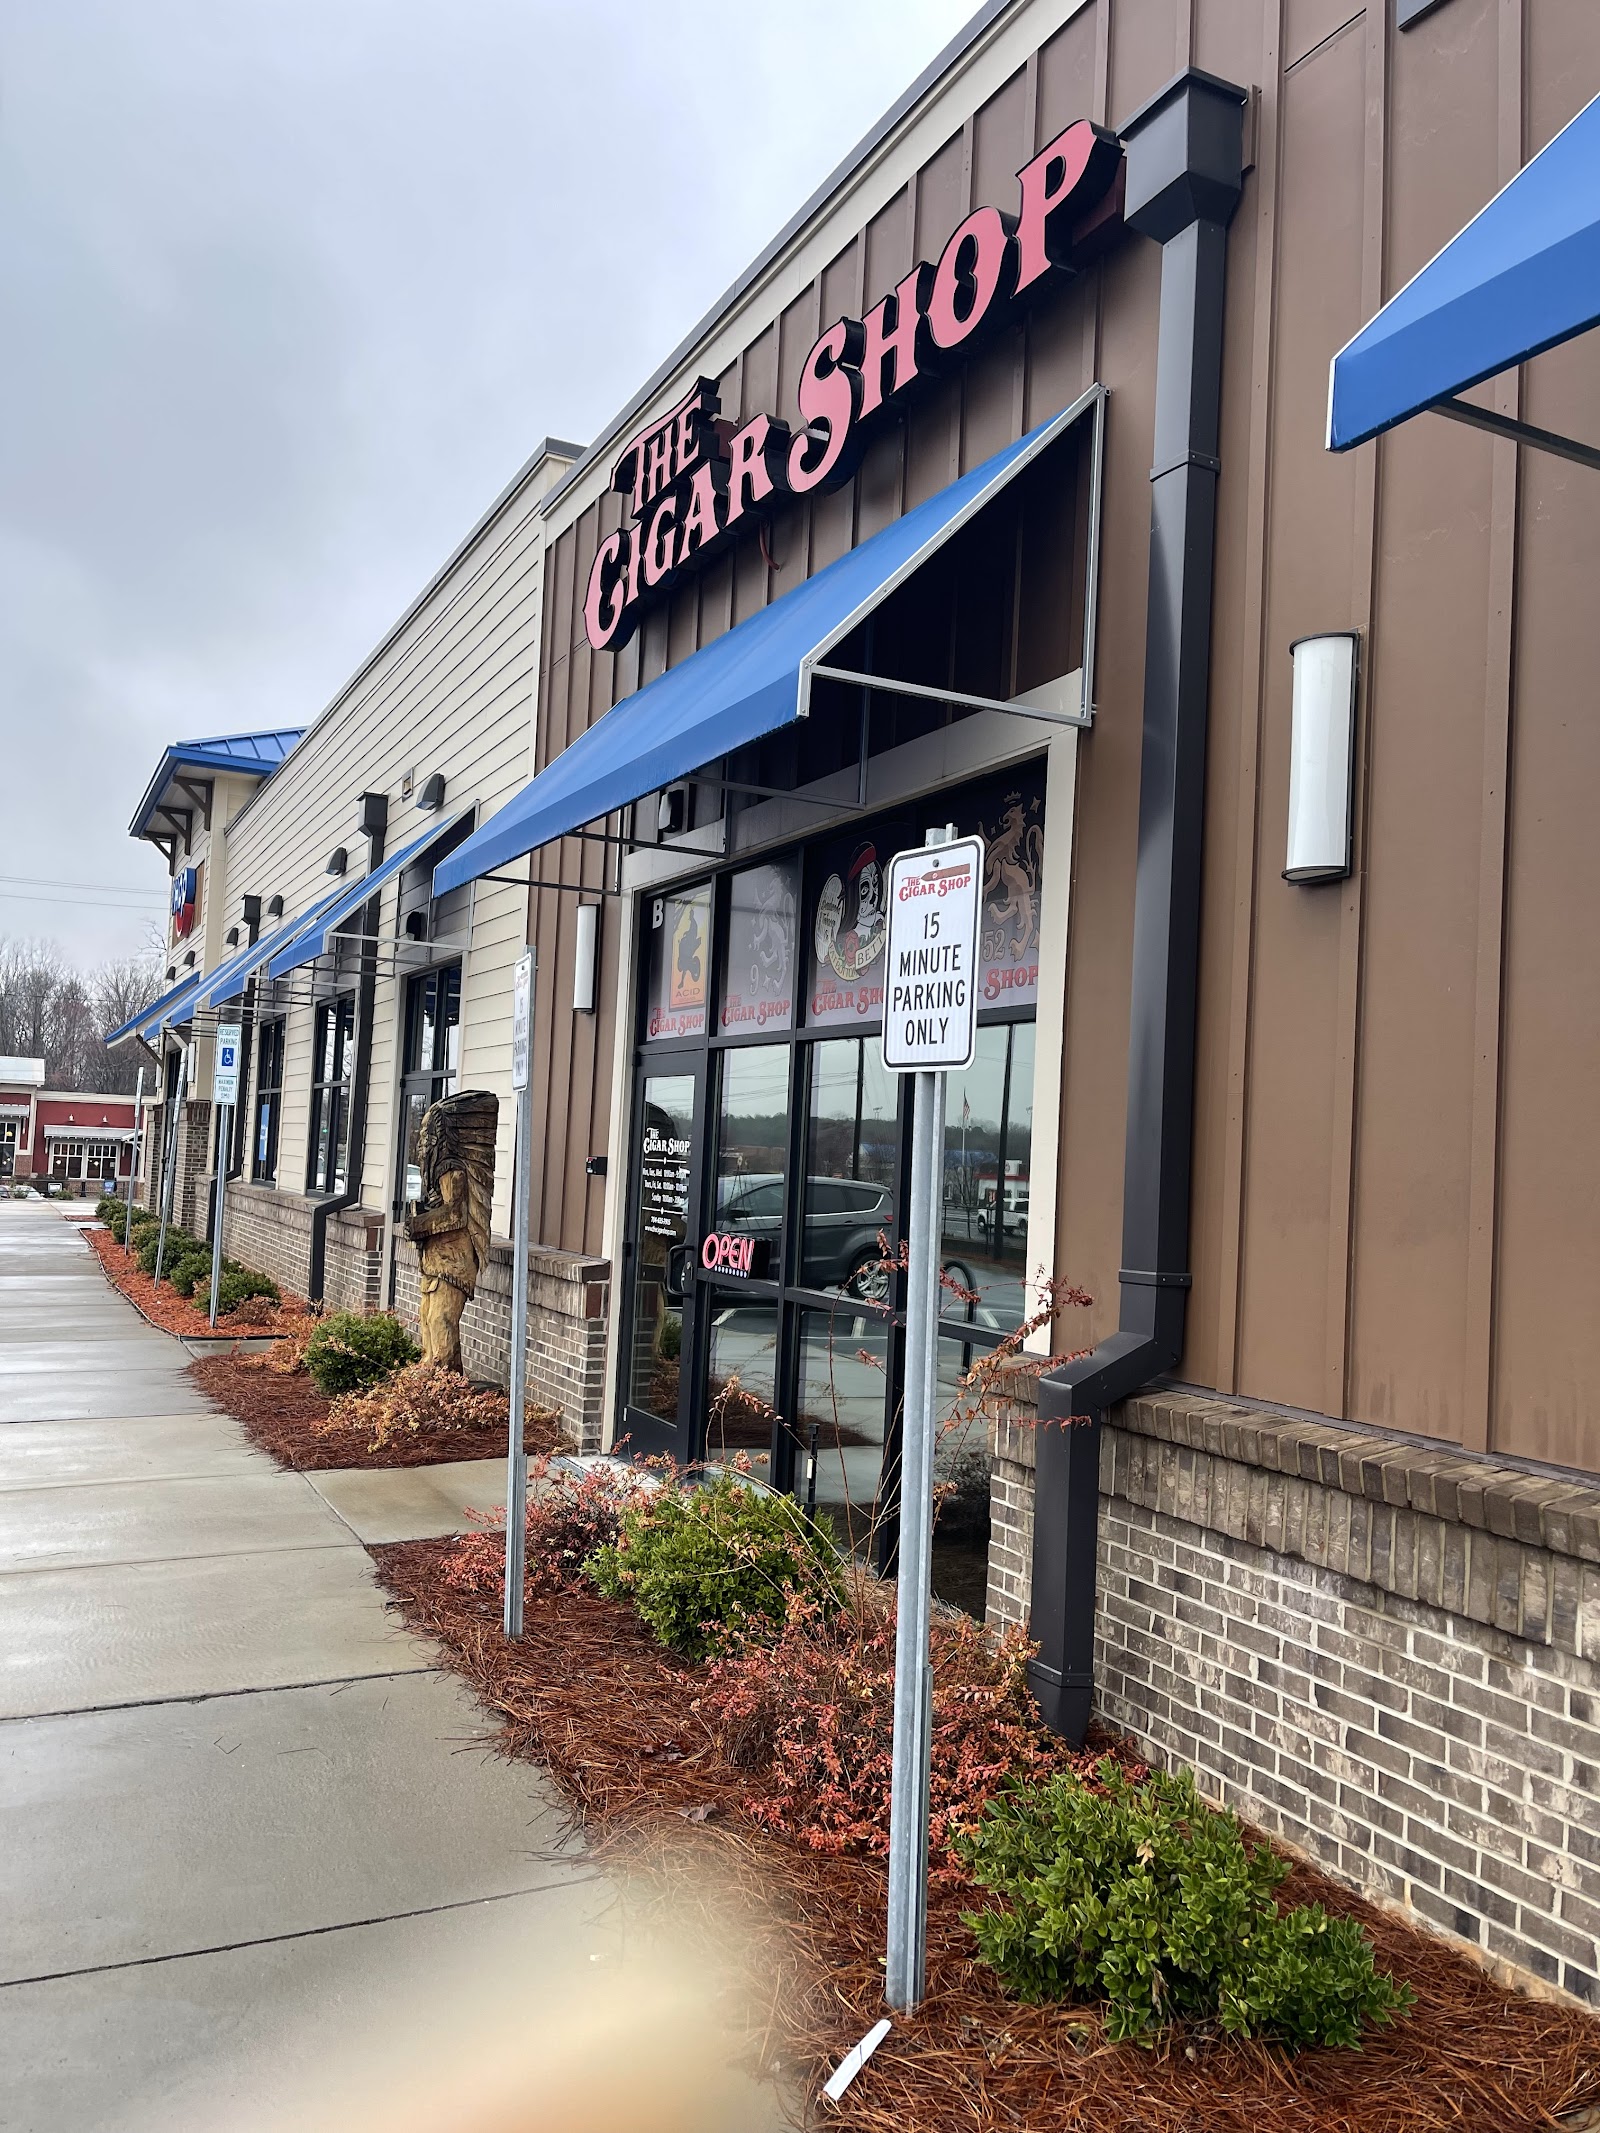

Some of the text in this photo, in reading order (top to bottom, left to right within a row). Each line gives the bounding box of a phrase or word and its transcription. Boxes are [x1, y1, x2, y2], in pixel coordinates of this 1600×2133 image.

[583, 118, 1099, 650] CIGAR SHOP
[609, 376, 704, 519] THE
[899, 876, 971, 902] CIGAR SHOP
[902, 876, 920, 887] THE
[652, 898, 664, 929] B
[924, 911, 940, 940] 15
[857, 935, 886, 966] BETT
[981, 928, 1006, 962] 52
[900, 944, 961, 977] MINUTE
[676, 987, 700, 998] ACID
[893, 979, 965, 1012] PARKING
[984, 966, 1038, 1000] SHOP
[721, 1000, 790, 1027] CIGAR SHOP
[812, 991, 855, 1016] CIGAR
[650, 1014, 704, 1036] CIGAR SHOP
[905, 1017, 949, 1046] ONLY
[220, 1038, 237, 1046] PARKING
[643, 1137, 690, 1155] CIGAR SHOP
[646, 1127, 660, 1140] THE
[702, 1233, 755, 1271] OPEN
